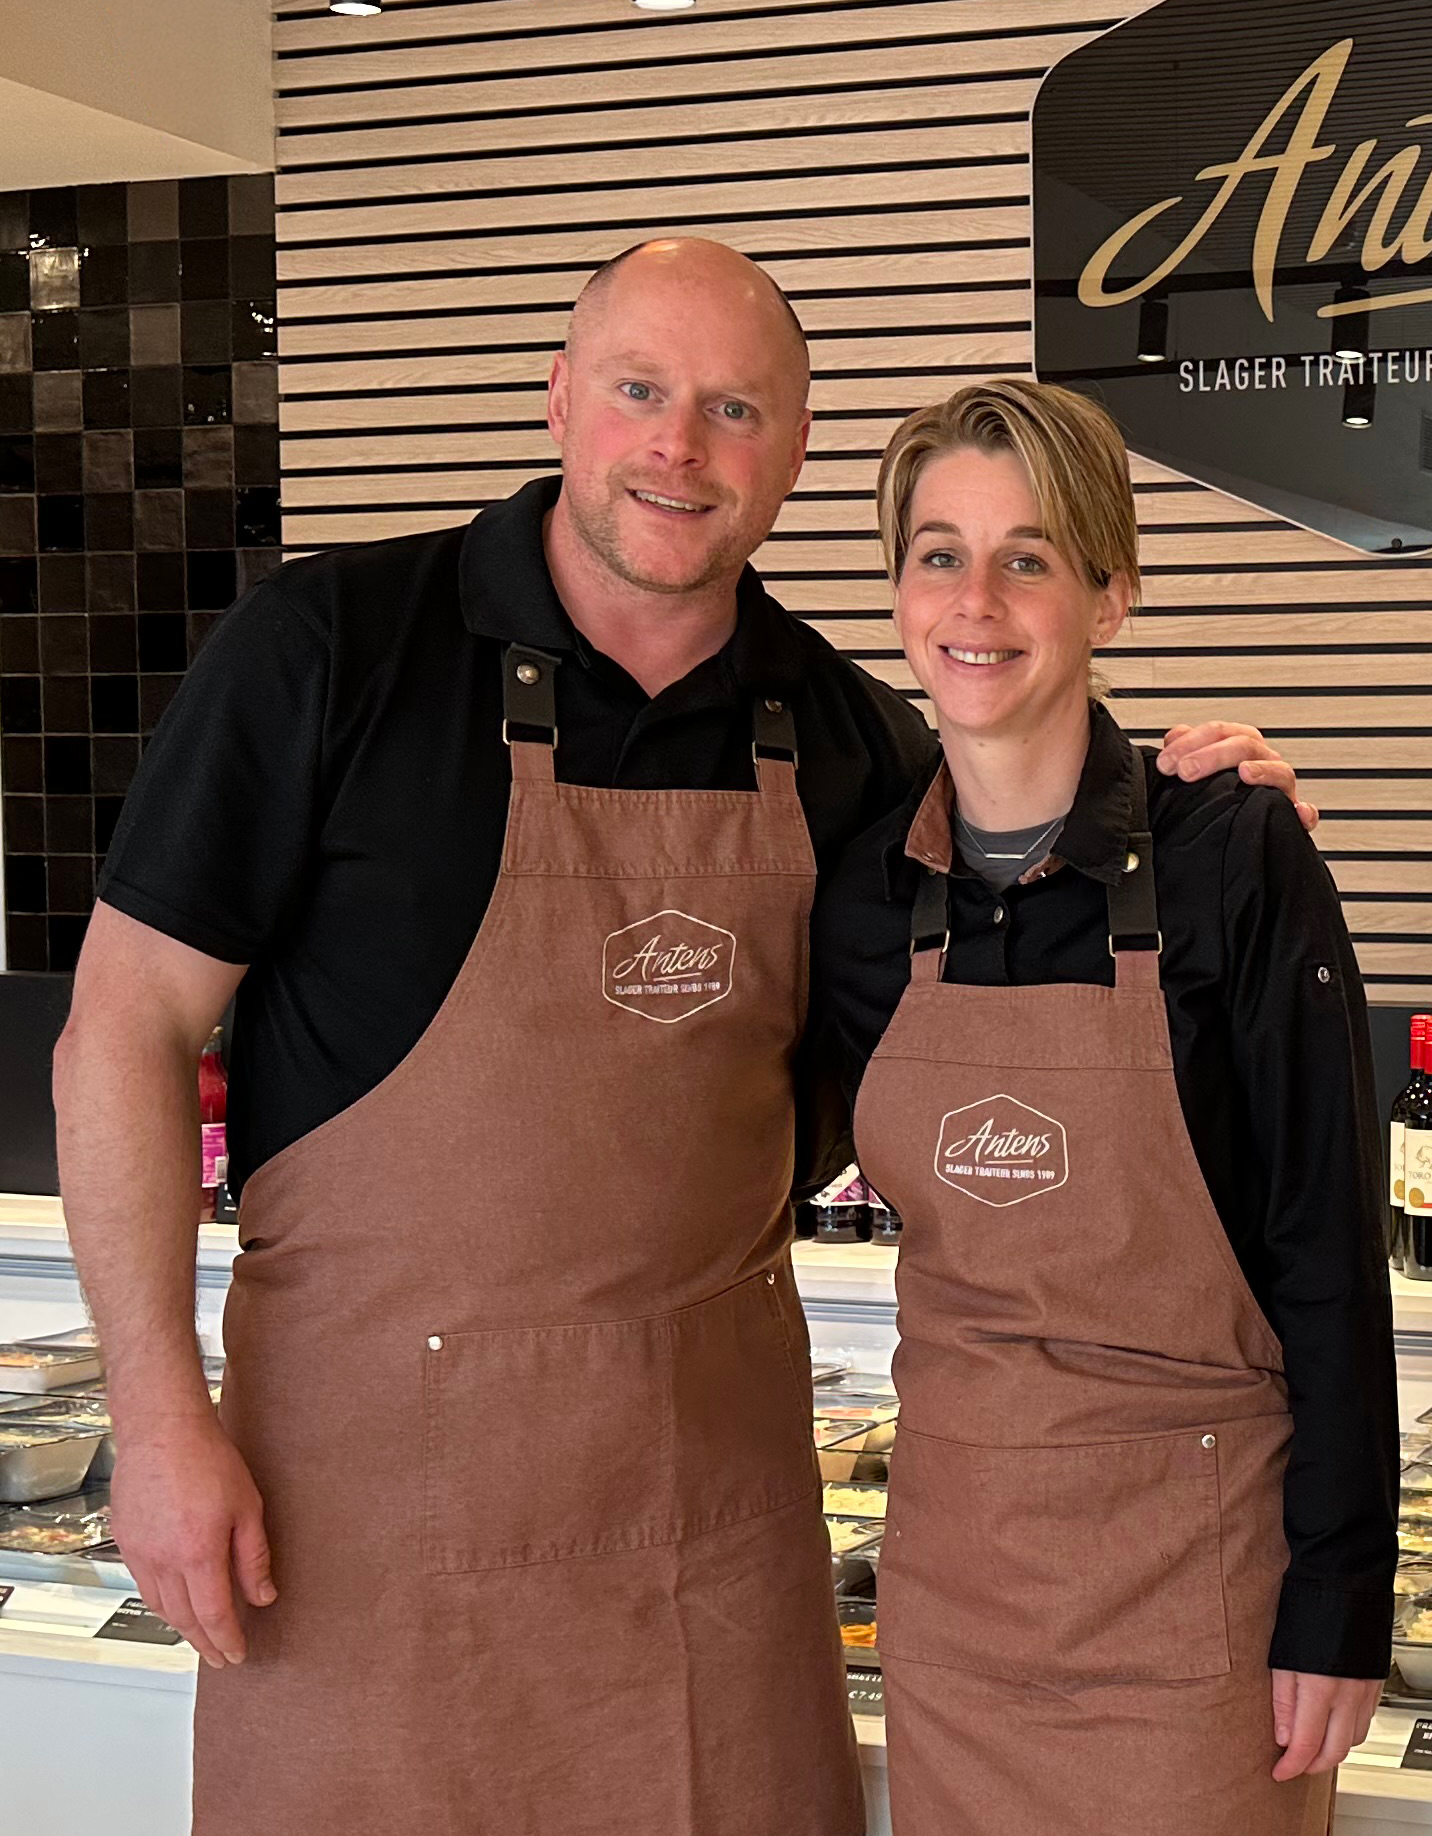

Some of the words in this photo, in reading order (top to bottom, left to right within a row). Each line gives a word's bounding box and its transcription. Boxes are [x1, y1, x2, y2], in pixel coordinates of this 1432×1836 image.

[1179, 356, 1287, 393] SLAGER
[613, 934, 722, 981] Antens
[944, 1118, 1052, 1164] Antens
[1408, 1170, 1432, 1180] TORO
